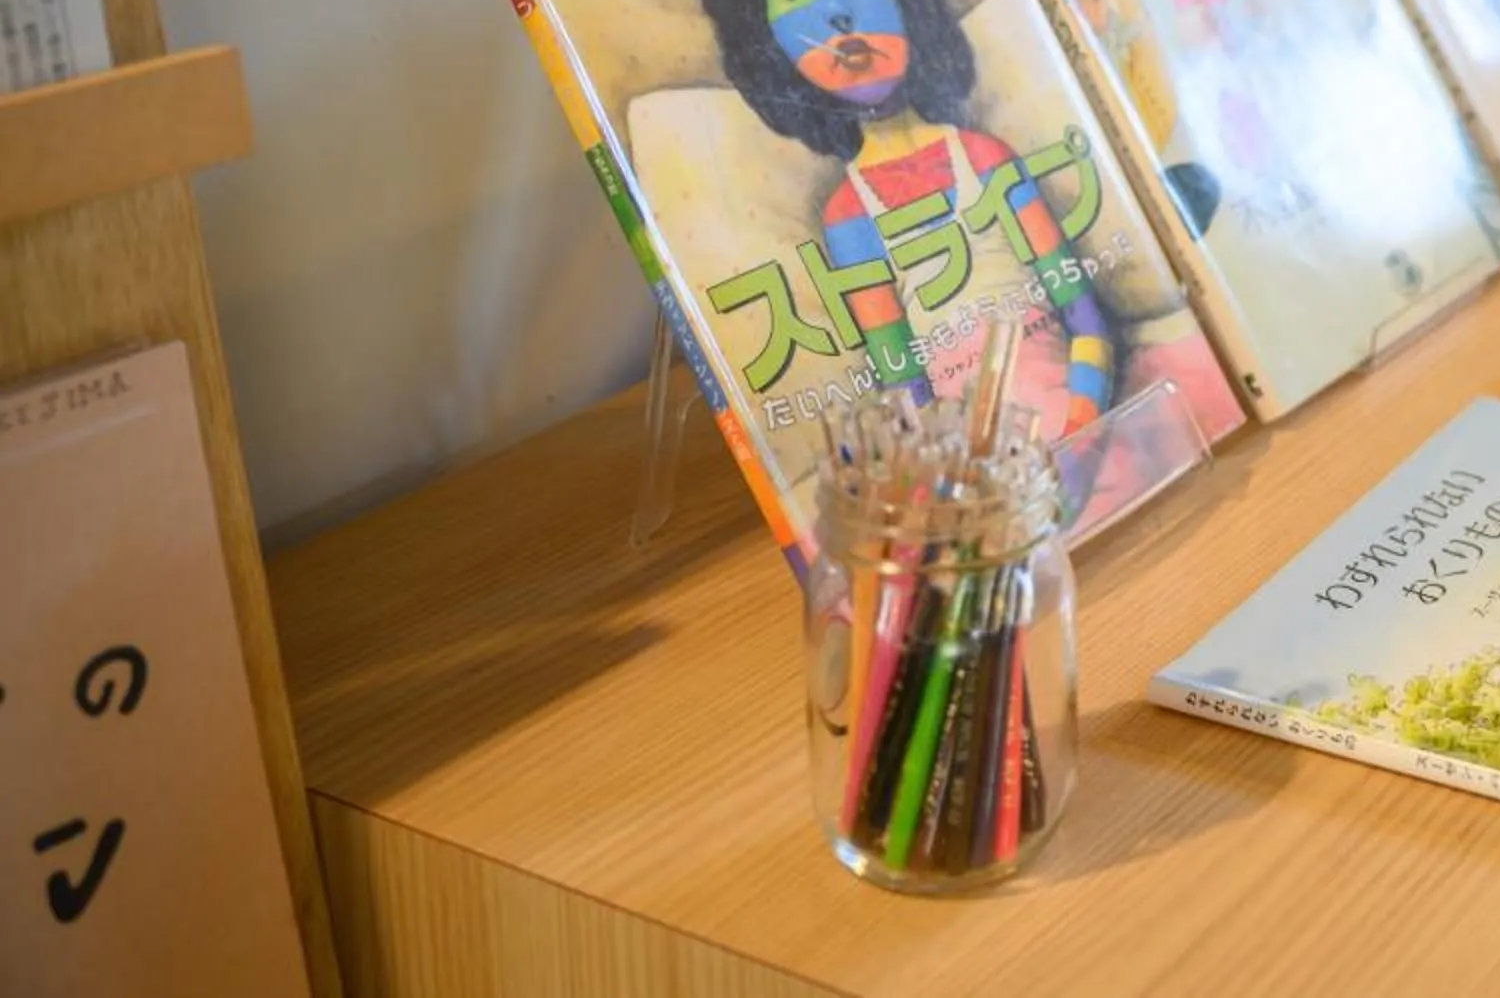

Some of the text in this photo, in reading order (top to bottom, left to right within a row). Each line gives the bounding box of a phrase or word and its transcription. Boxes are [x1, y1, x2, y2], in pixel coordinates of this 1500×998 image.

[706, 123, 1103, 394] ストライプ
[1315, 469, 1486, 610] わすれられない
